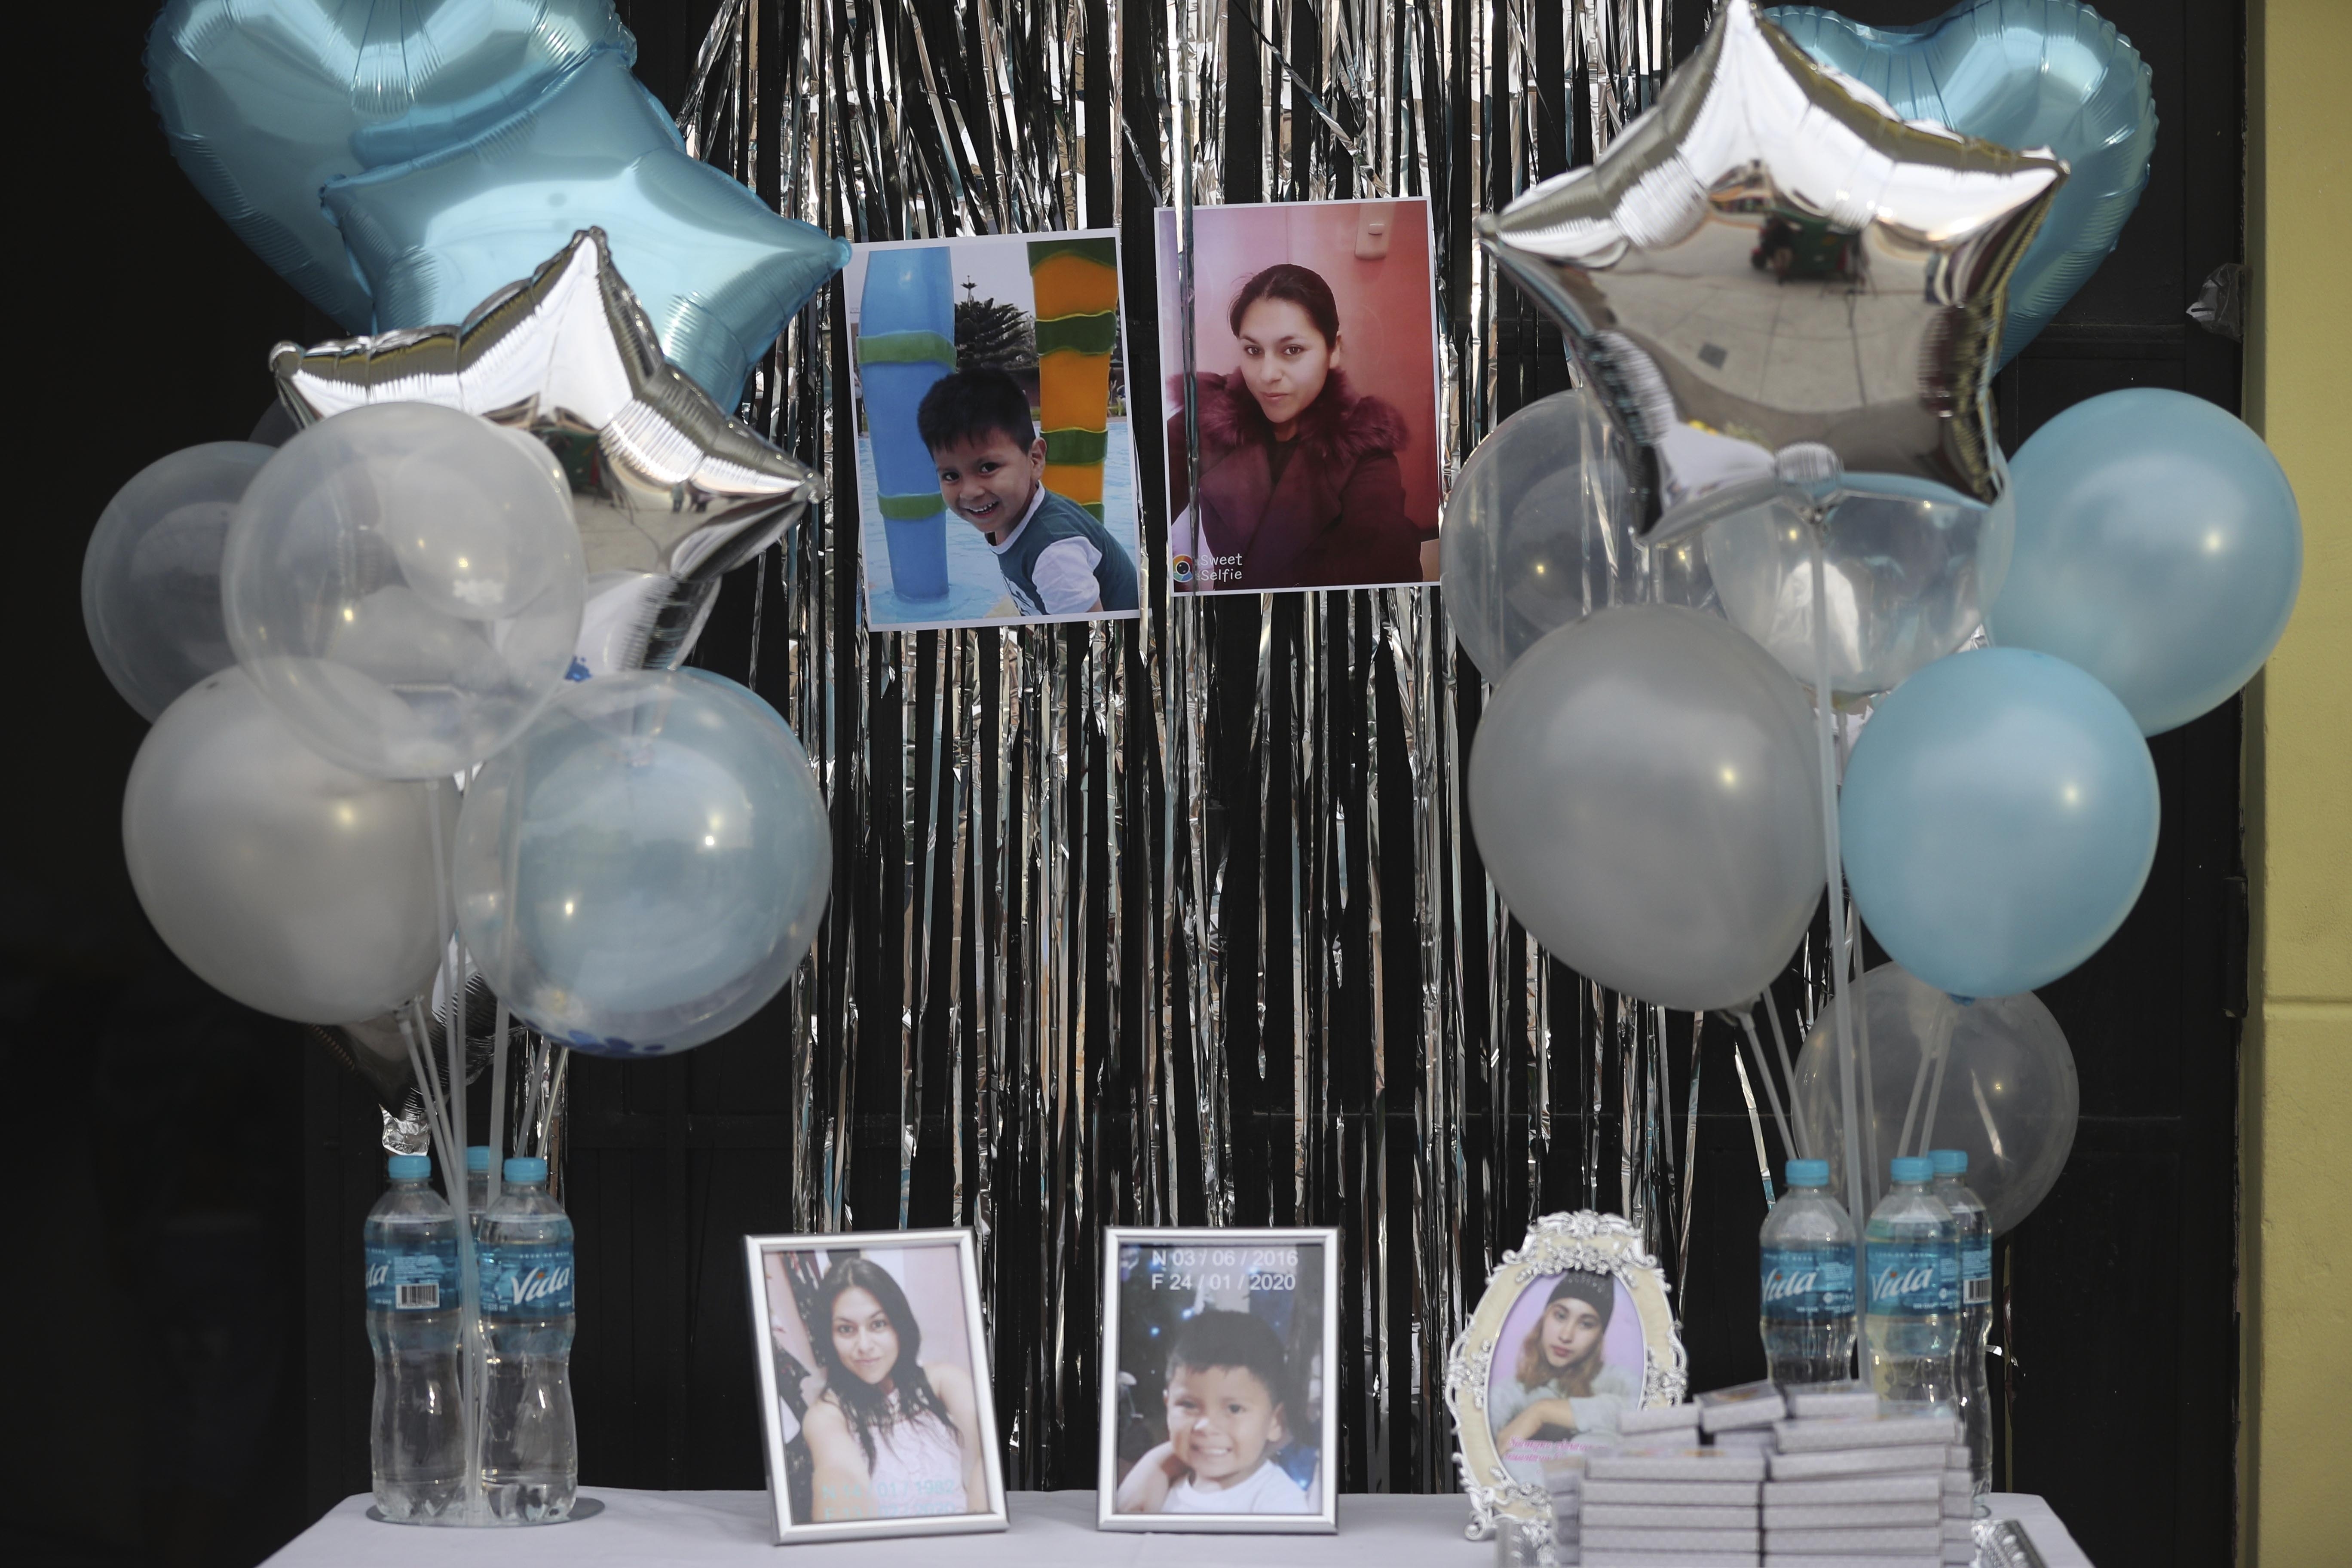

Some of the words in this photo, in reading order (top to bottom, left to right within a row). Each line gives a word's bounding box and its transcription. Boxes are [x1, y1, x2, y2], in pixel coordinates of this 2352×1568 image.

[1201, 553, 1242, 566] Sweet
[1200, 568, 1242, 582] Selfie
[1152, 1249, 1166, 1266] N
[1172, 1250, 1195, 1266] 03
[1212, 1250, 1235, 1266] 06
[1253, 1249, 1298, 1267] 2016
[511, 1267, 570, 1305] Vida
[1152, 1274, 1164, 1290] F
[1169, 1274, 1193, 1290] 24
[1209, 1274, 1230, 1290] 01
[1250, 1273, 1296, 1290] 2020
[1761, 1268, 1817, 1304] Vida
[1871, 1265, 1933, 1302] Vida
[822, 1485, 836, 1500] N
[878, 1482, 896, 1498] 01
[916, 1478, 954, 1495] 1982
[824, 1507, 836, 1521] F
